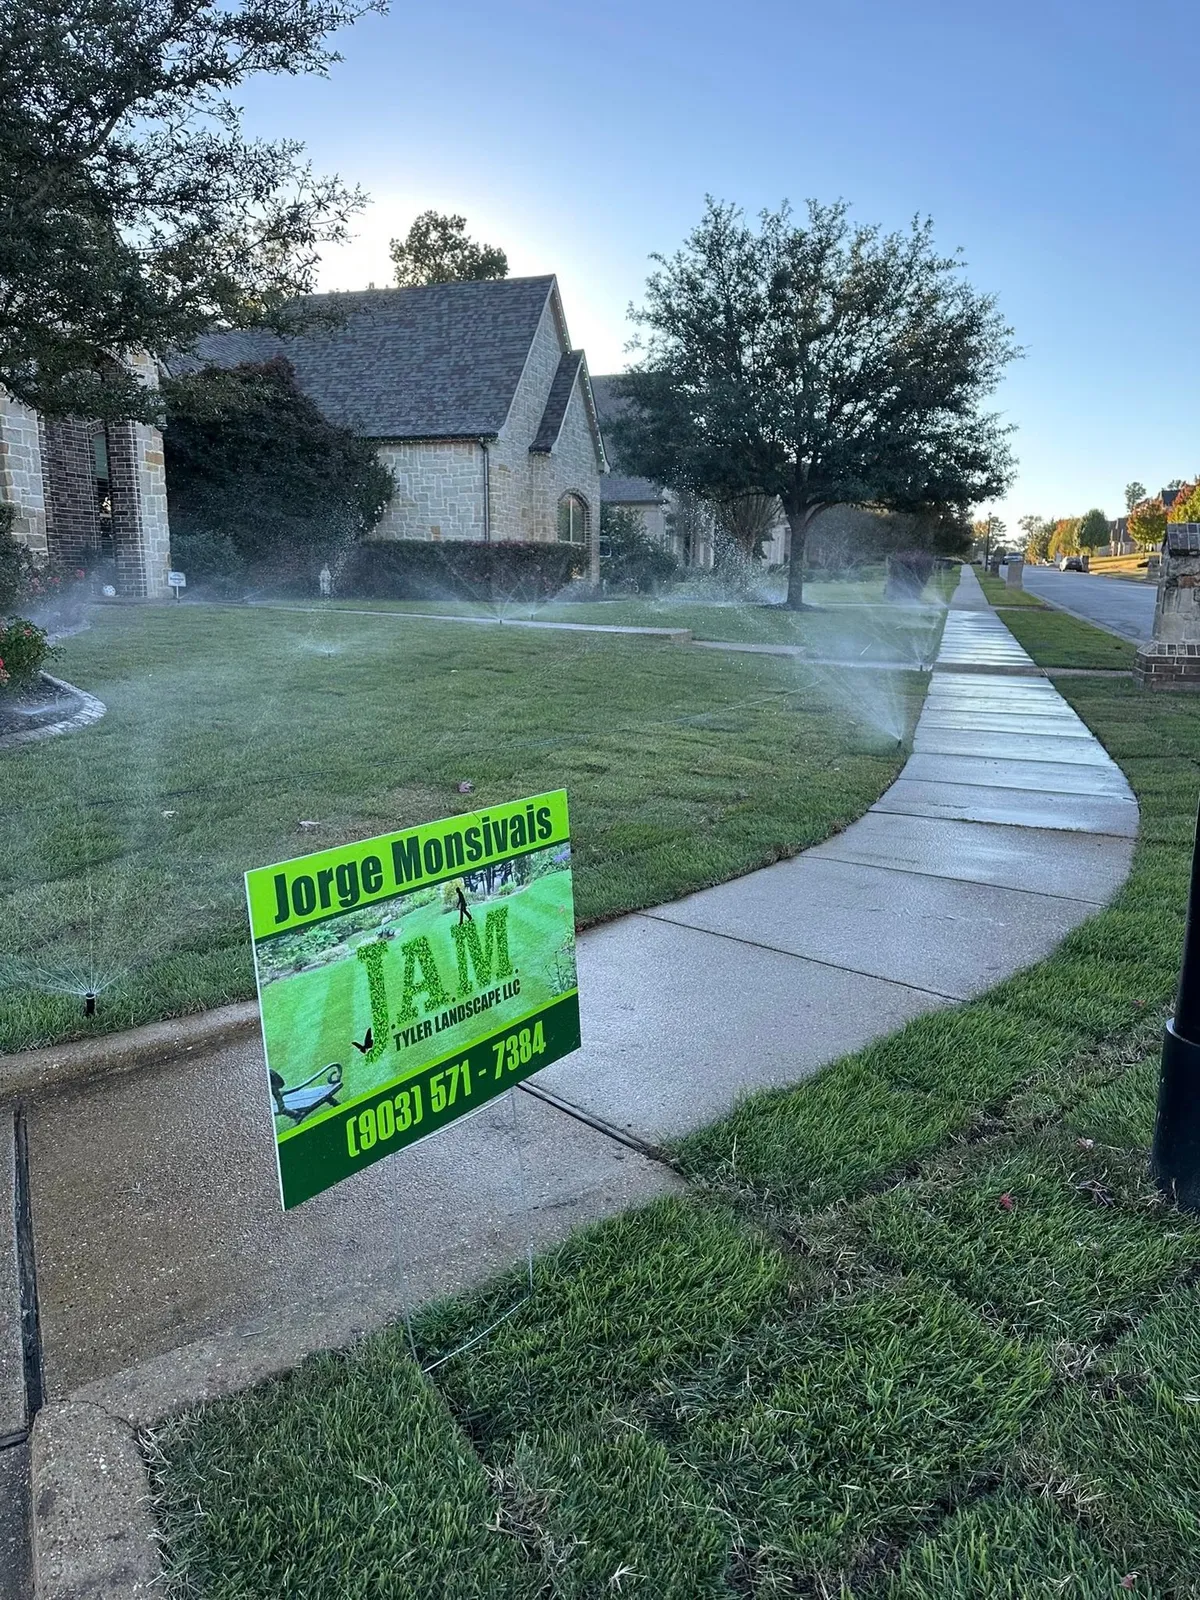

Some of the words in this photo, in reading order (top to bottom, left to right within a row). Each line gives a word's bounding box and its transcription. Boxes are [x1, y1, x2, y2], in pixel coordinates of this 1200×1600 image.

[274, 855, 382, 924] Jorge
[391, 804, 552, 885] Monsivais
[393, 1019, 432, 1051] TYLER
[435, 990, 501, 1033] LANDSCAPE
[502, 978, 521, 1001] LLC
[346, 1085, 423, 1158] (903)
[430, 1059, 472, 1114] 571
[492, 1020, 546, 1079] 7384
